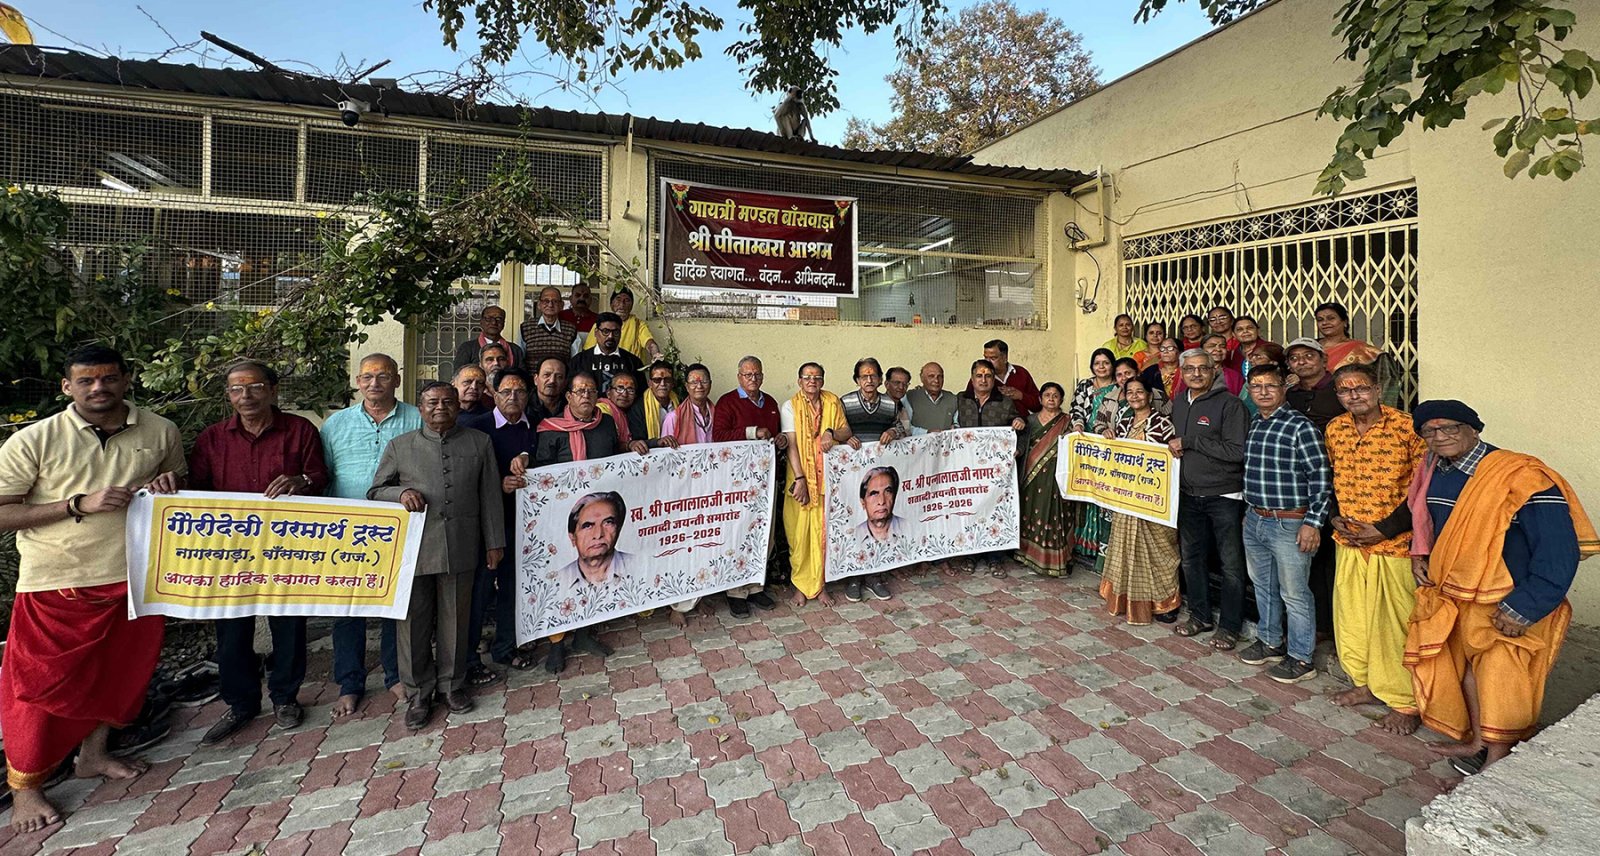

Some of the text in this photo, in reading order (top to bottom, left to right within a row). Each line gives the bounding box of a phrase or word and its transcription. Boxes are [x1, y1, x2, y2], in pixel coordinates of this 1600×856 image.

[688, 199, 834, 232] गायत्री मण्डल बाँसवाड़ा
[688, 225, 832, 260] श्री पीताम्बरा आश्रम
[673, 258, 845, 288] हार्दिक स्वागत... वंदन... अभिनंदन...
[592, 362, 624, 371] Light
[1114, 453, 1144, 467] परमार्थ
[902, 479, 914, 491] स्व.
[915, 474, 924, 488] श्री
[972, 468, 994, 480] नागर
[630, 490, 749, 522] स्व. श्री पन्नालालजी नागर
[270, 519, 348, 540] परमार्थ
[352, 524, 396, 546] ट्रस्ट
[638, 509, 740, 537] शताब्दी जयन्ती समारोह
[176, 545, 380, 566] नागरवाड़ा, बाँसवाड़ा (राज.)
[164, 572, 214, 587] आपका
[219, 571, 268, 588] हार्दिक
[272, 574, 321, 586] स्वागत
[325, 575, 361, 587] करता
